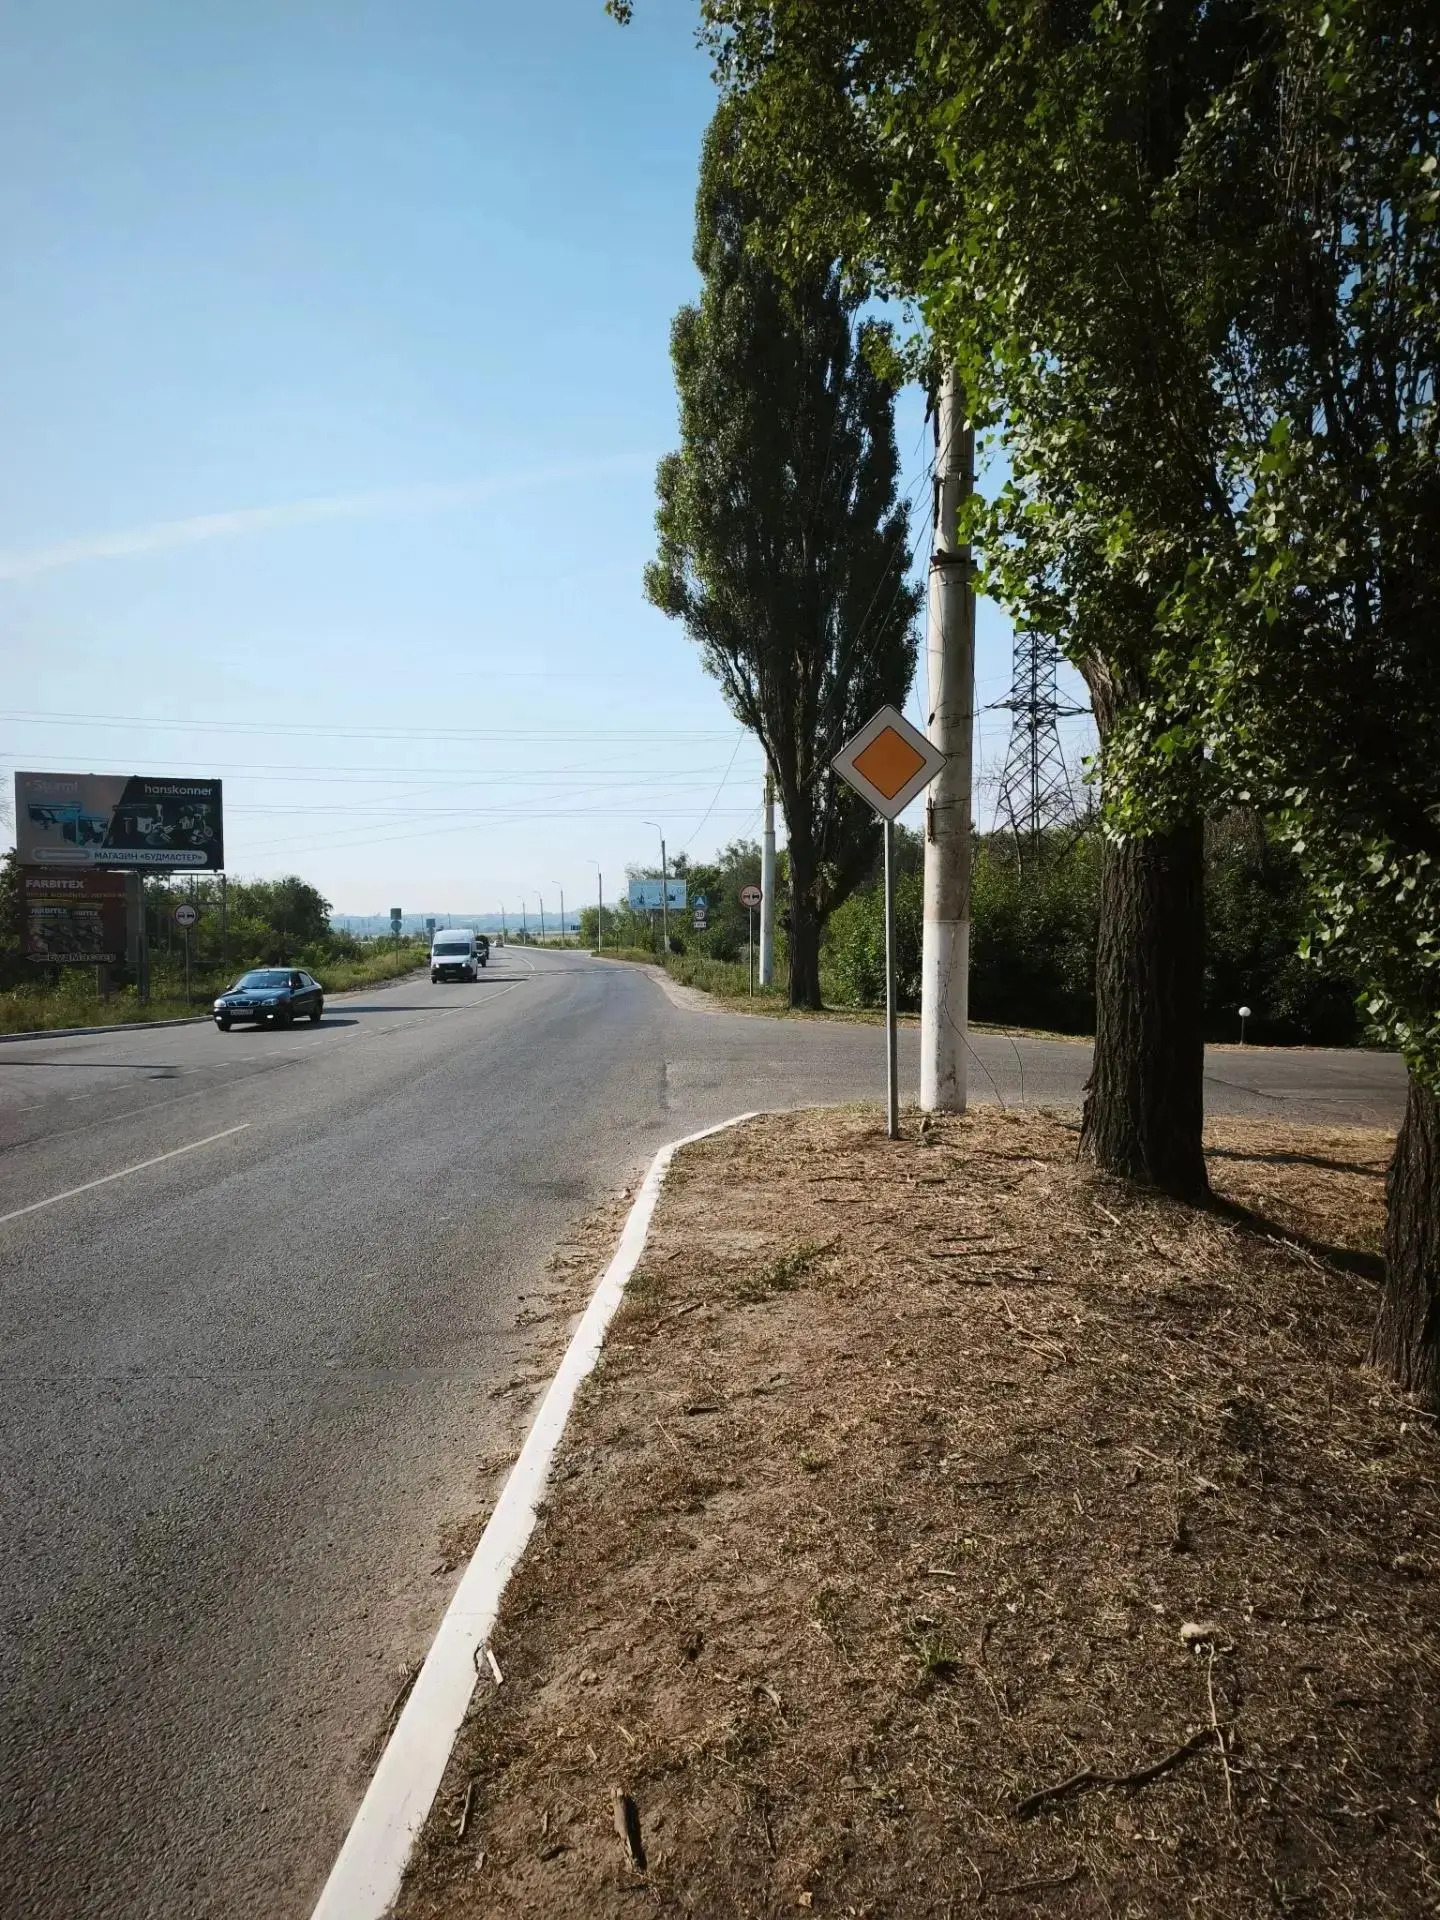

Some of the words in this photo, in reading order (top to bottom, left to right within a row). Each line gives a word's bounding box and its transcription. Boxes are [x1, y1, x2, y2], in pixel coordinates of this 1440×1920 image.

[144, 784, 212, 796] hanskonner
[94, 852, 138, 860] МАГАЗИН
[140, 853, 203, 861] «БУДМАСТЕР»
[25, 879, 85, 889] FARBITEX
